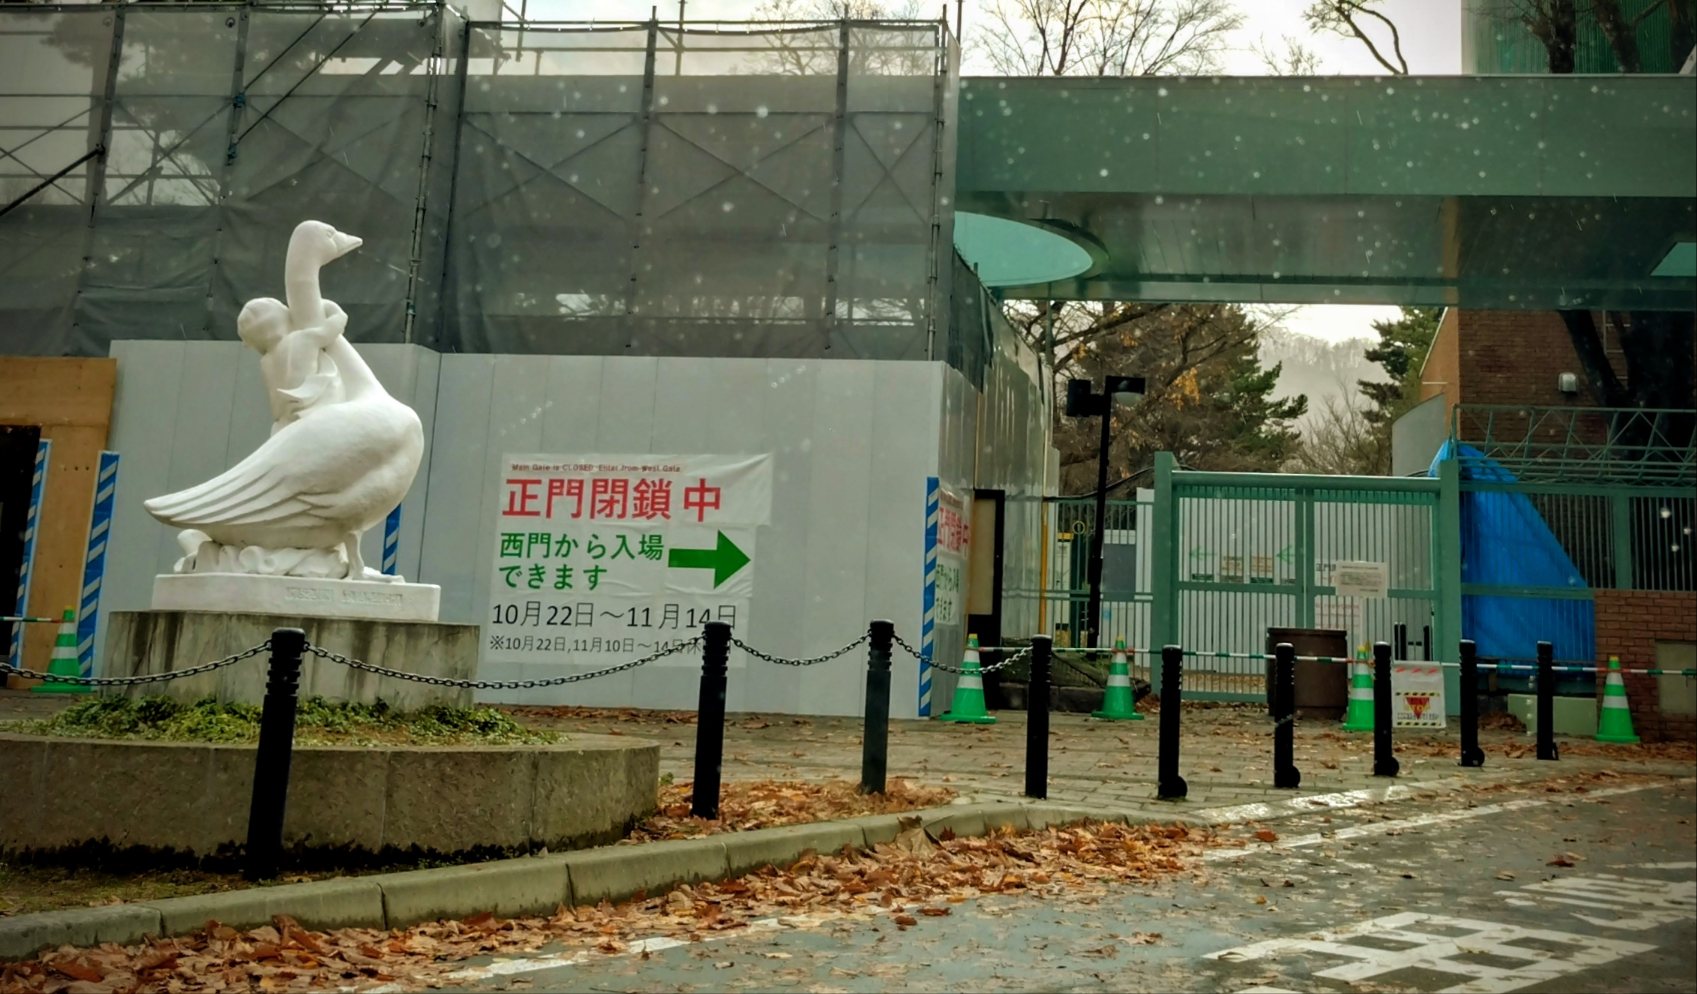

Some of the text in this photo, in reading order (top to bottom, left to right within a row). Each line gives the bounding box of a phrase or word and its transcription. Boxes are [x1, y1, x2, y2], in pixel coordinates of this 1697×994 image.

[511, 463, 529, 472] Main
[532, 463, 551, 472] Gate
[562, 463, 594, 473] CLOSED
[502, 478, 722, 522] 正門閉鎖中
[499, 532, 665, 561] 西門から入場
[499, 564, 608, 590] できます
